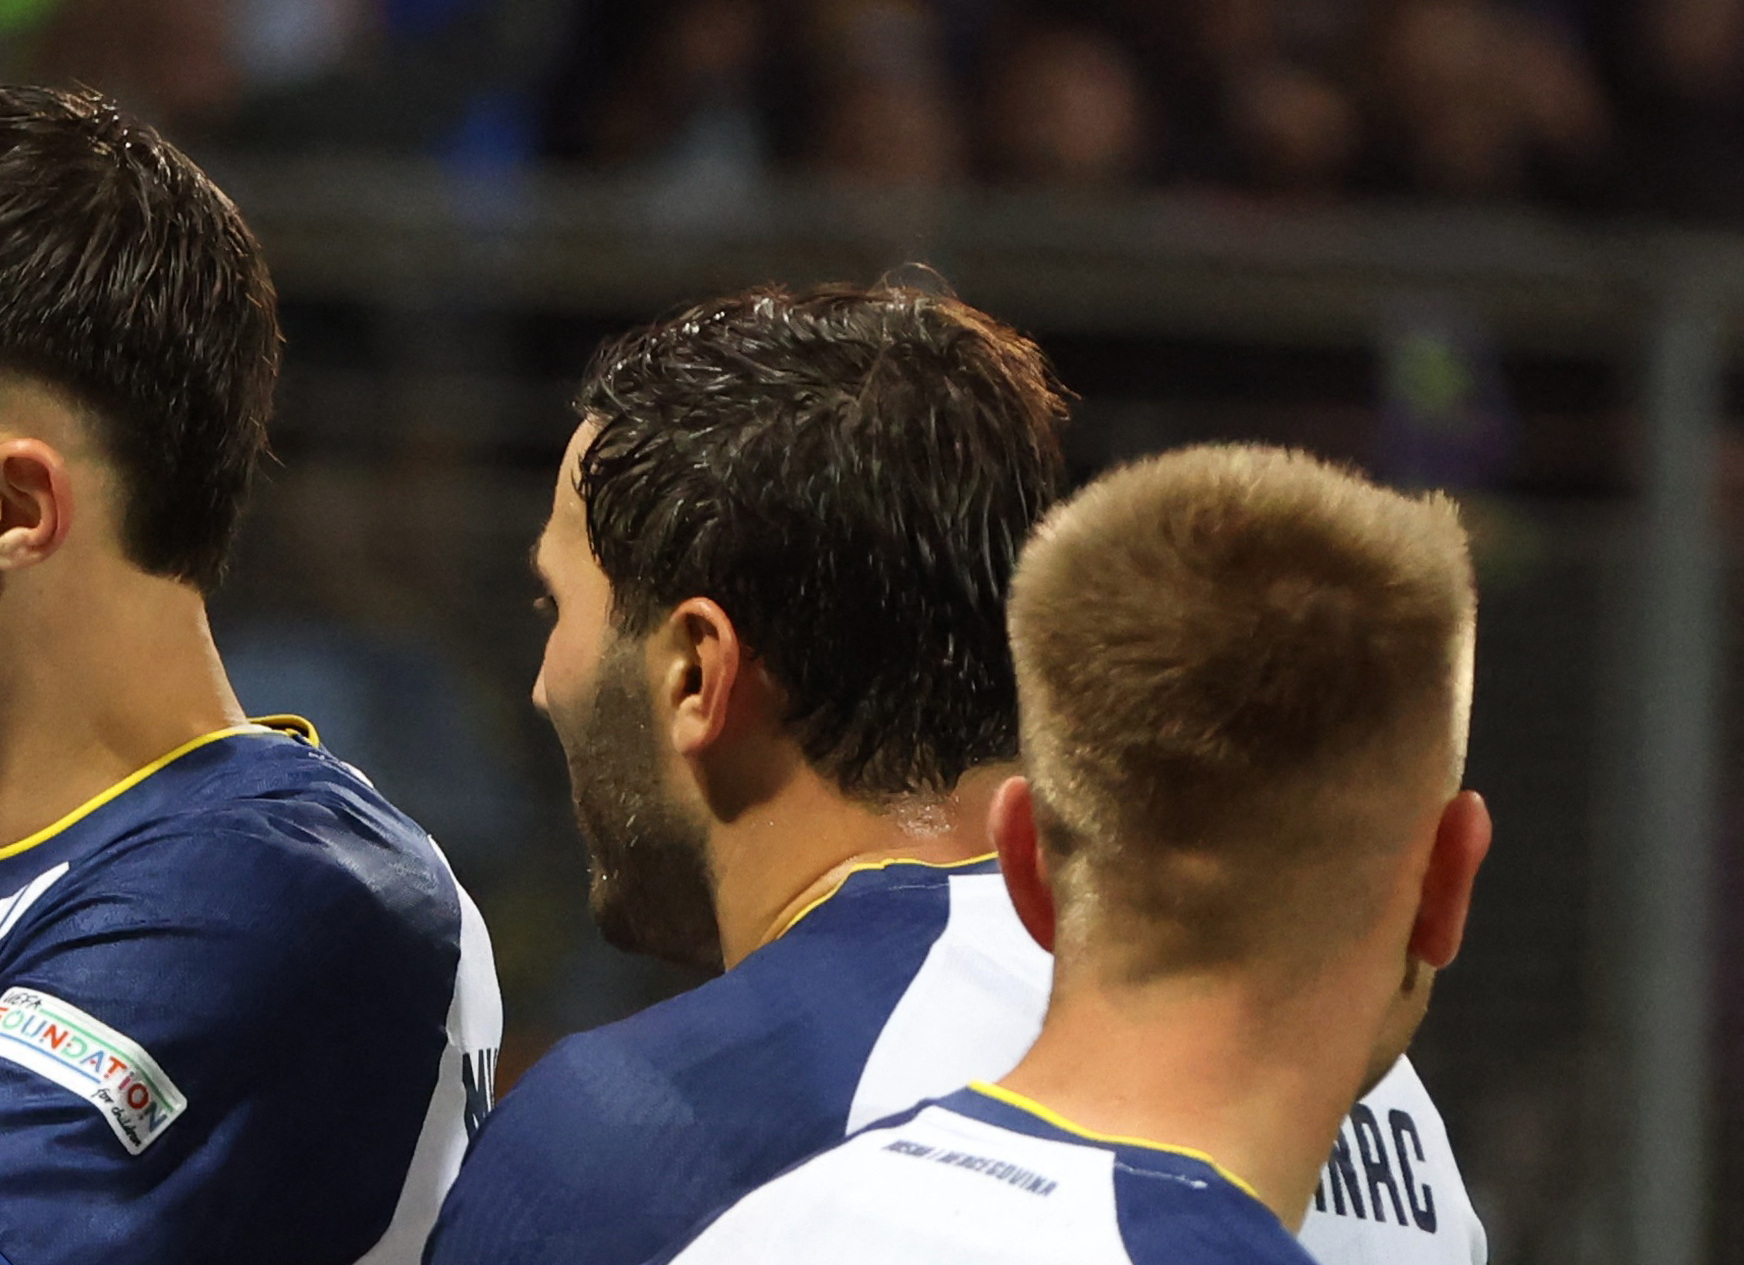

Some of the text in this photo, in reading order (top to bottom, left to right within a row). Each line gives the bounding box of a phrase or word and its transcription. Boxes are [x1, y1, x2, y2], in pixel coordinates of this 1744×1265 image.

[3, 991, 42, 1010] UEFA
[91, 1087, 142, 1147] for children
[1315, 1101, 1438, 1235] NAC
